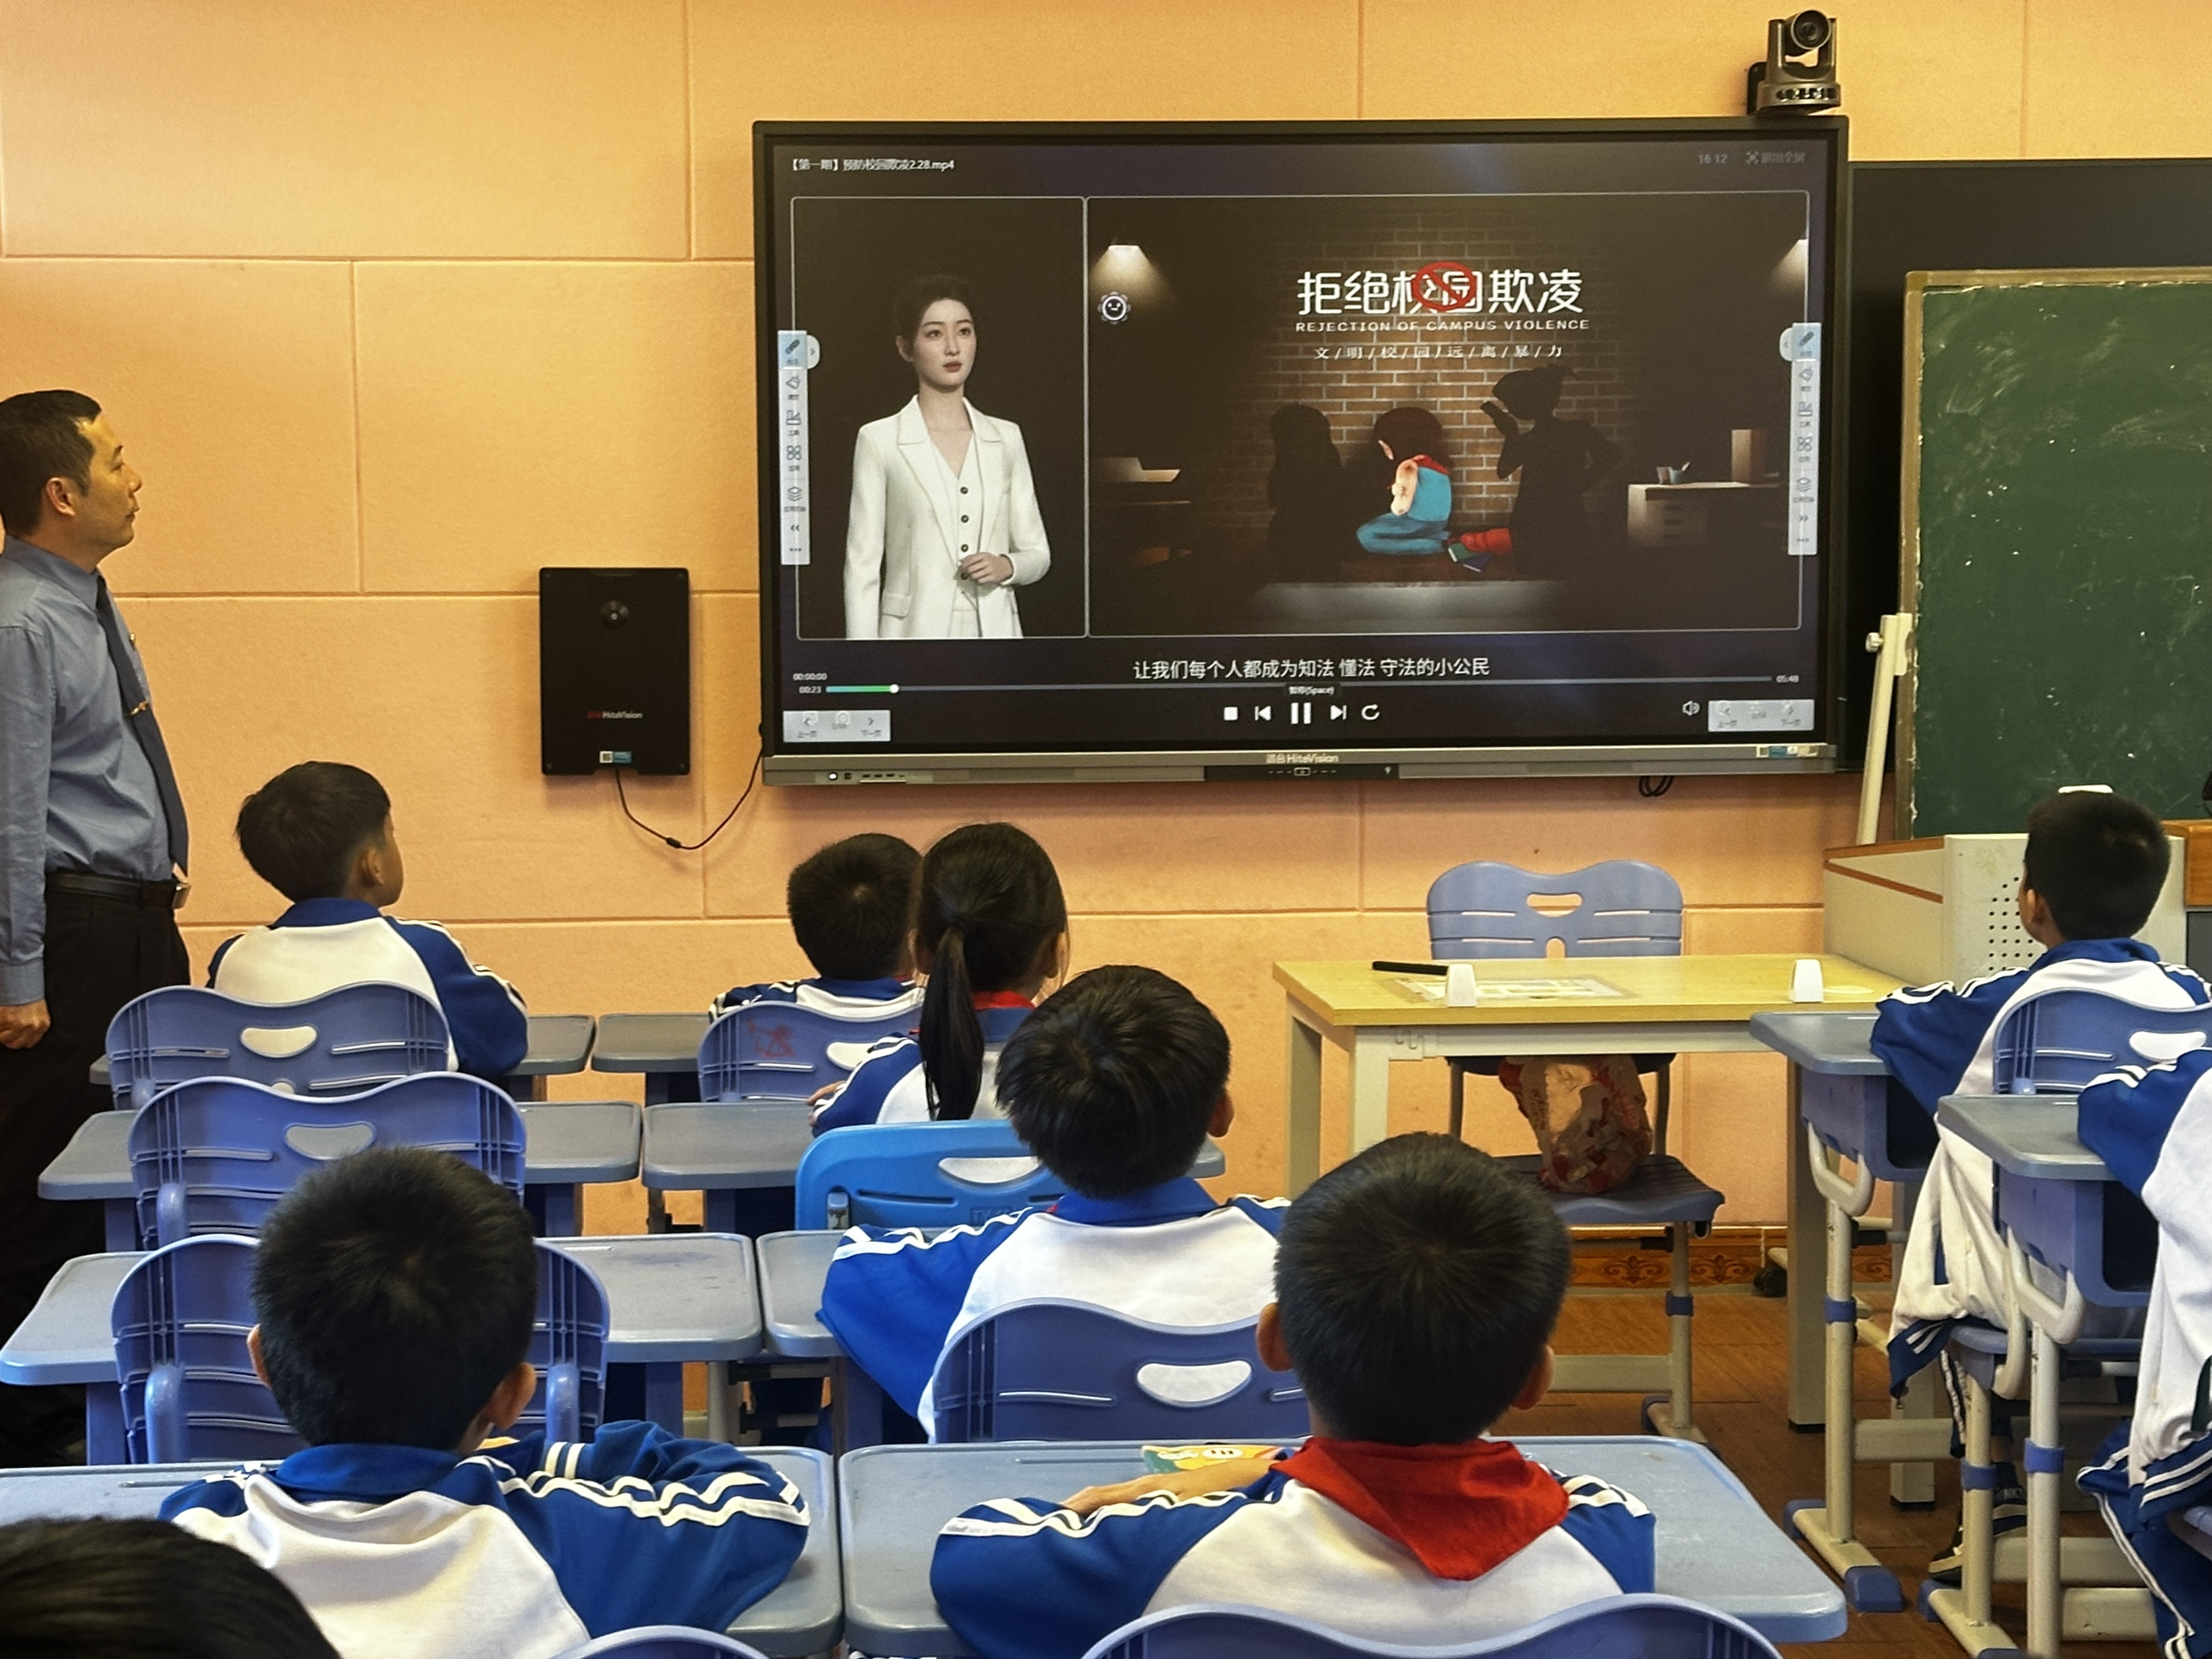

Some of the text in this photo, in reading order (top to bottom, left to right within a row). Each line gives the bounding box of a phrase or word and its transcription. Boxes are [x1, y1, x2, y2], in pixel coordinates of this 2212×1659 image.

[1297, 269, 1583, 315] 拒绝校园欺凌
[1296, 319, 1589, 332] REJECTION OF CAMPUS VIOLENCE
[1133, 658, 1490, 679] 让我们每个人都成为知法 懂法 守法的小公民
